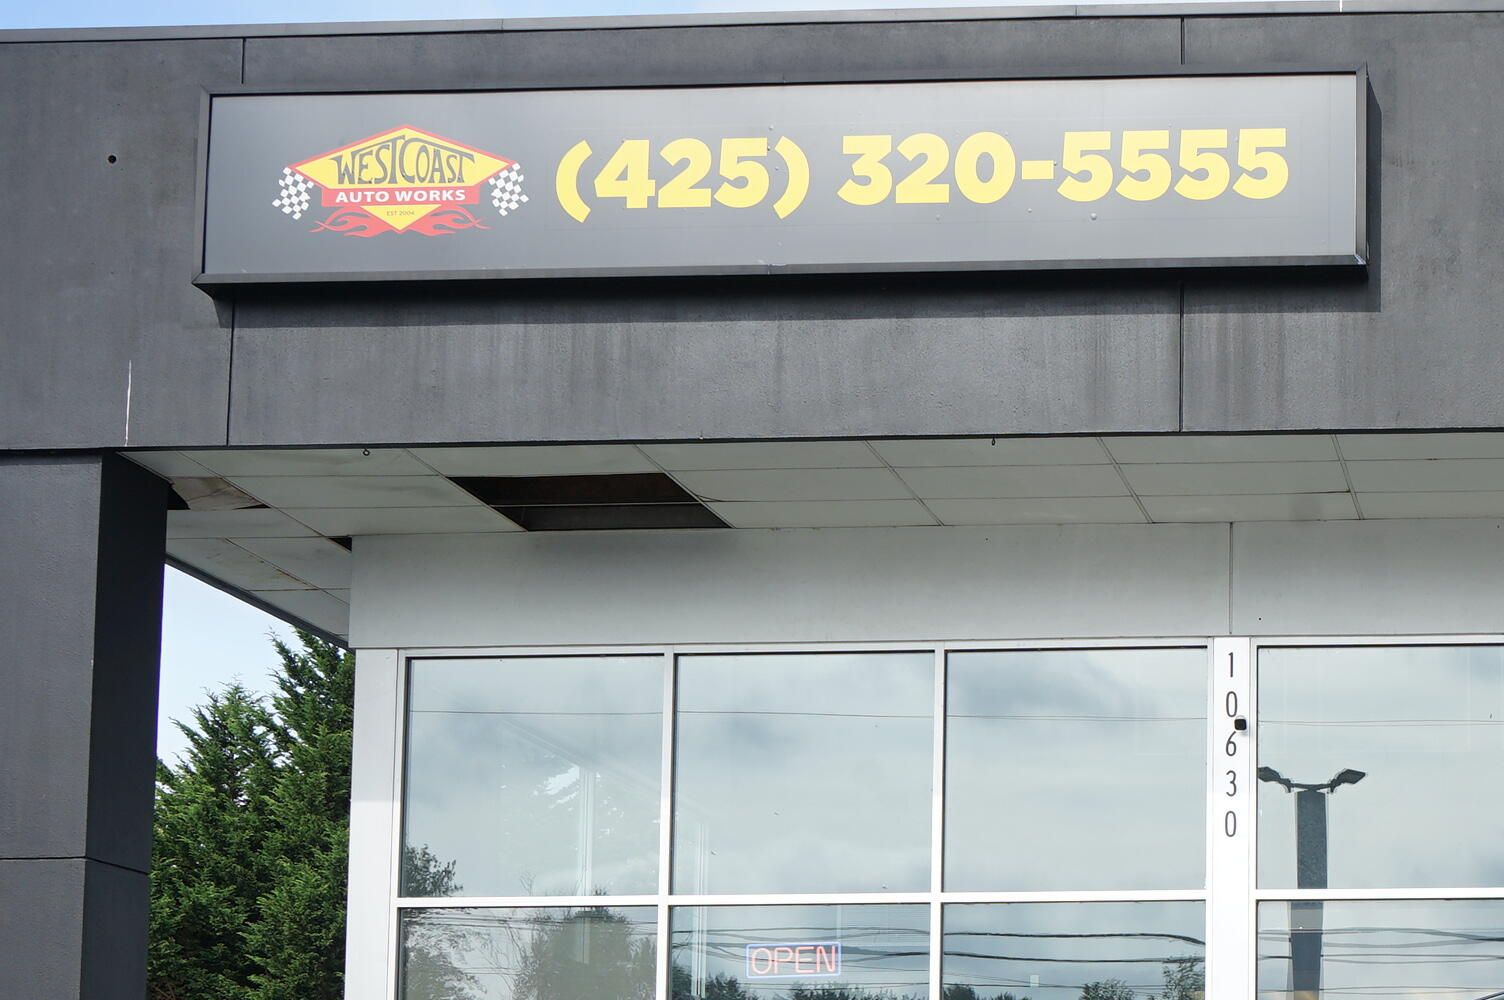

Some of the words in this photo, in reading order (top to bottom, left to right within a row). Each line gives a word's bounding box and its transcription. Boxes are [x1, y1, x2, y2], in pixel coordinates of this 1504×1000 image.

[335, 191, 390, 203] AUTO
[395, 189, 466, 202] WORKS
[555, 136, 810, 223] (425)
[837, 128, 1289, 206] 320-5555
[1225, 651, 1239, 838] 10630
[751, 944, 836, 975] OPEN
